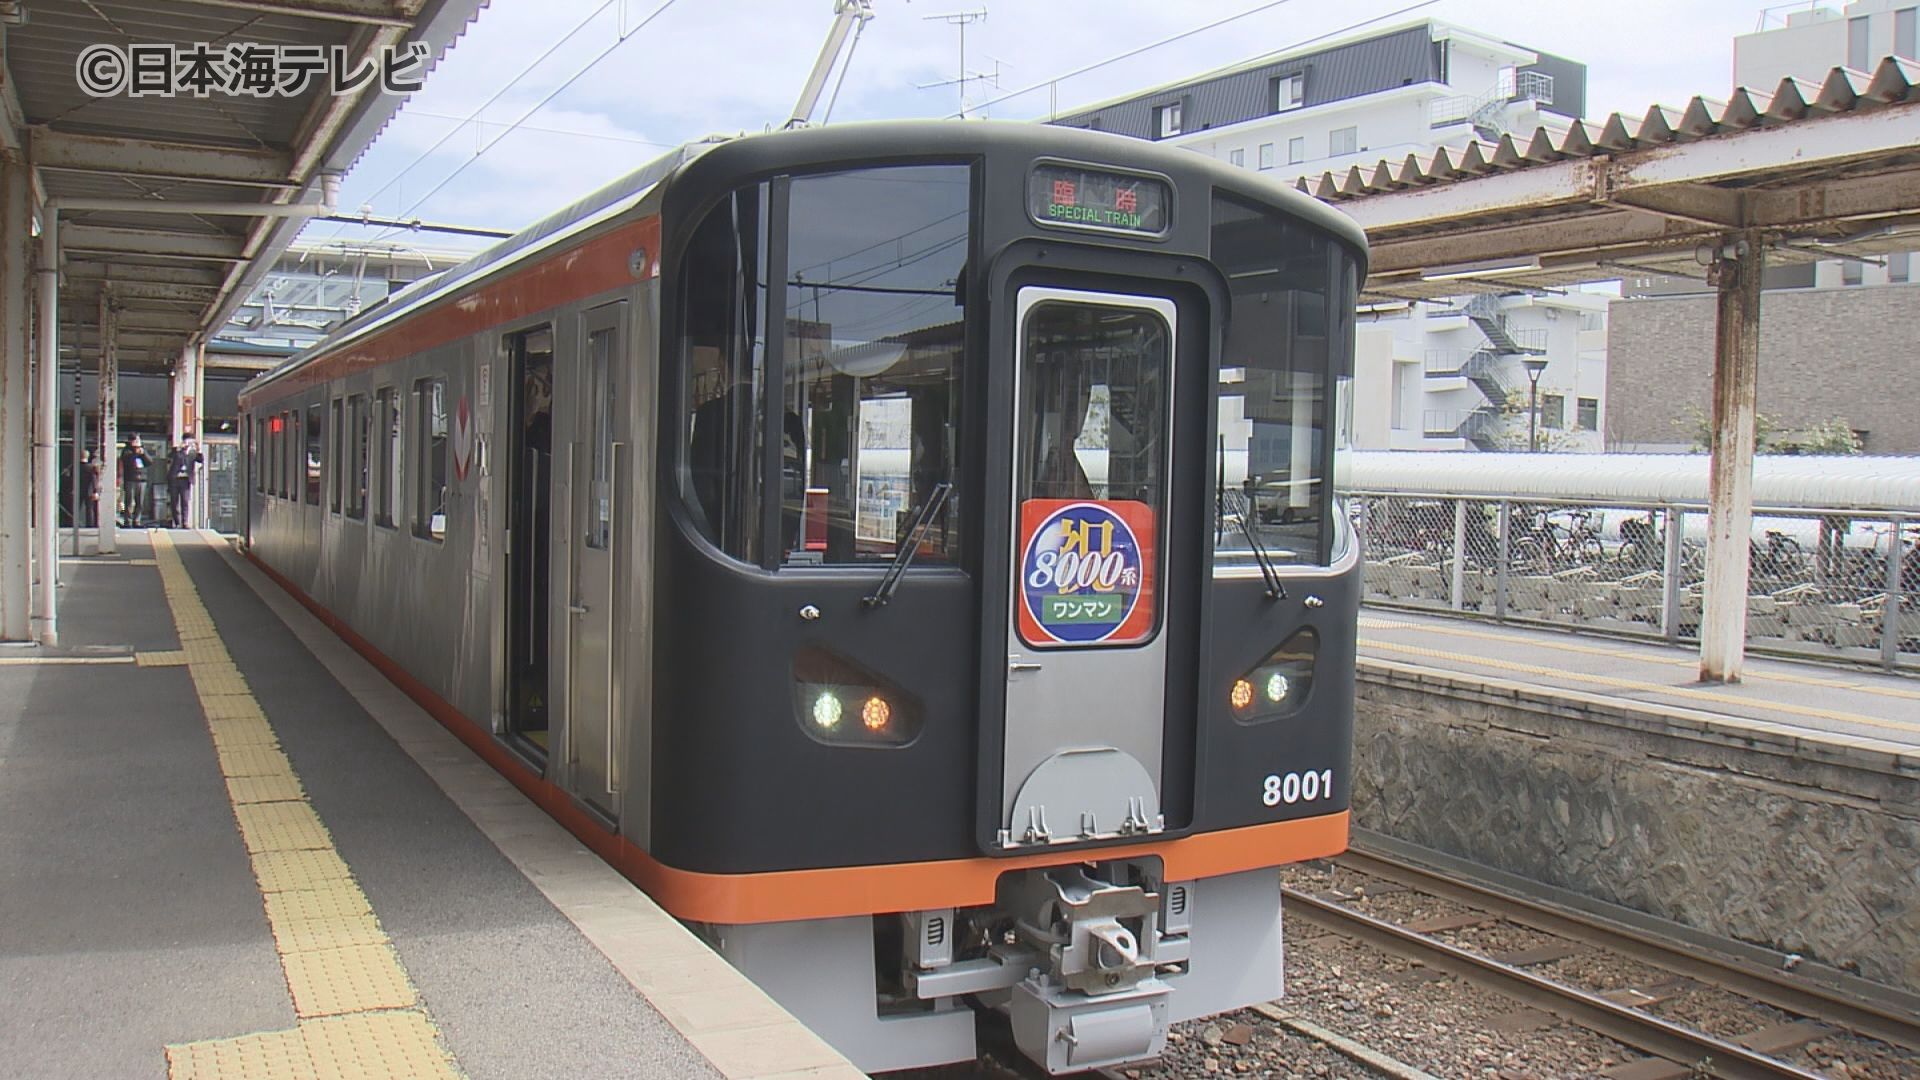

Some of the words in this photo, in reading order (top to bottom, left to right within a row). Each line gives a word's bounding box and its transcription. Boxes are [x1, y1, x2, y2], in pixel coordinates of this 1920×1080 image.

[1049, 204, 1102, 222] SPECIAL
[1105, 210, 1141, 228] TRAIN
[1053, 602, 1112, 618] ワンマン
[1263, 769, 1332, 806] 8001
